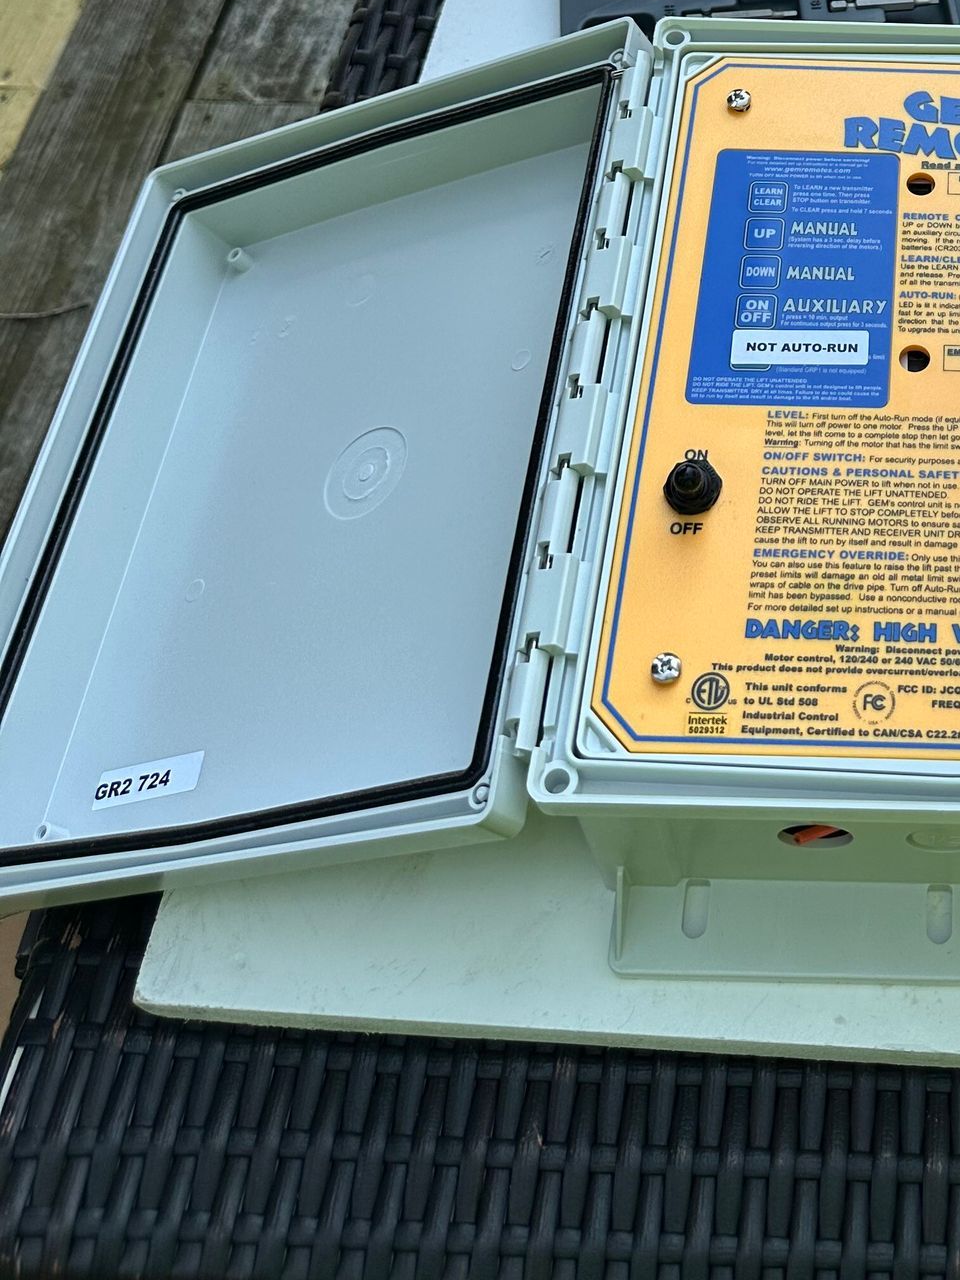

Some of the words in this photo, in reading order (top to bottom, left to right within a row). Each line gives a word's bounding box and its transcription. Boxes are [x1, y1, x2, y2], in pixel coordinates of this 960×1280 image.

[921, 161, 950, 170] Read
[755, 188, 783, 196] LEARN
[903, 213, 949, 221] REMOTE
[754, 229, 776, 238] UP
[791, 222, 858, 236] MANUAL
[746, 267, 775, 277] DOWN
[786, 266, 855, 281] MANUAL
[899, 291, 956, 300] AUTO-RUN:
[746, 301, 769, 310] ON
[783, 298, 887, 315] AUXILIARY
[741, 312, 772, 323] OFF
[746, 342, 777, 352] NOT
[781, 343, 858, 353] AUTO-RUN
[767, 410, 809, 419] LEVEL:
[685, 449, 708, 460] ON
[763, 452, 809, 461] ON/OFF
[813, 453, 865, 462] SWITCH:
[762, 467, 828, 476] CAUTIONS
[833, 468, 841, 476] &
[846, 468, 913, 478] PERSONAL
[789, 478, 807, 486] OFF
[835, 479, 869, 487] POWER
[670, 522, 703, 535] OFF
[753, 549, 835, 559] EMERGENCY
[840, 550, 909, 560] OVERRIDE:
[745, 618, 860, 642] DANGER:
[874, 621, 937, 643] HIGH
[835, 645, 880, 654] Warning:
[886, 646, 942, 655] Disconnect
[764, 653, 795, 662] Motor
[797, 654, 836, 664] control,
[839, 655, 878, 664] 120/240
[895, 657, 913, 665] 240
[917, 658, 937, 666] VAC
[712, 663, 733, 671] This
[736, 664, 777, 673] product
[825, 666, 863, 675] provide
[745, 682, 768, 691] This
[772, 683, 793, 692] unit
[796, 684, 847, 693] conforms
[898, 685, 918, 693] FCC
[922, 685, 936, 694] ID:
[744, 697, 755, 705] to
[758, 697, 773, 705] UL
[777, 697, 795, 706] Std
[798, 698, 818, 706] 508
[688, 715, 727, 725] Intertek
[743, 711, 795, 721] Industrial
[799, 712, 839, 721] Control
[688, 726, 725, 734] 5029312
[741, 725, 803, 736] Equipment,
[807, 726, 855, 736] Certified
[859, 728, 869, 737] to
[873, 729, 923, 738] CAN/CSA
[94, 778, 133, 801] GR2
[138, 769, 172, 792] 724
